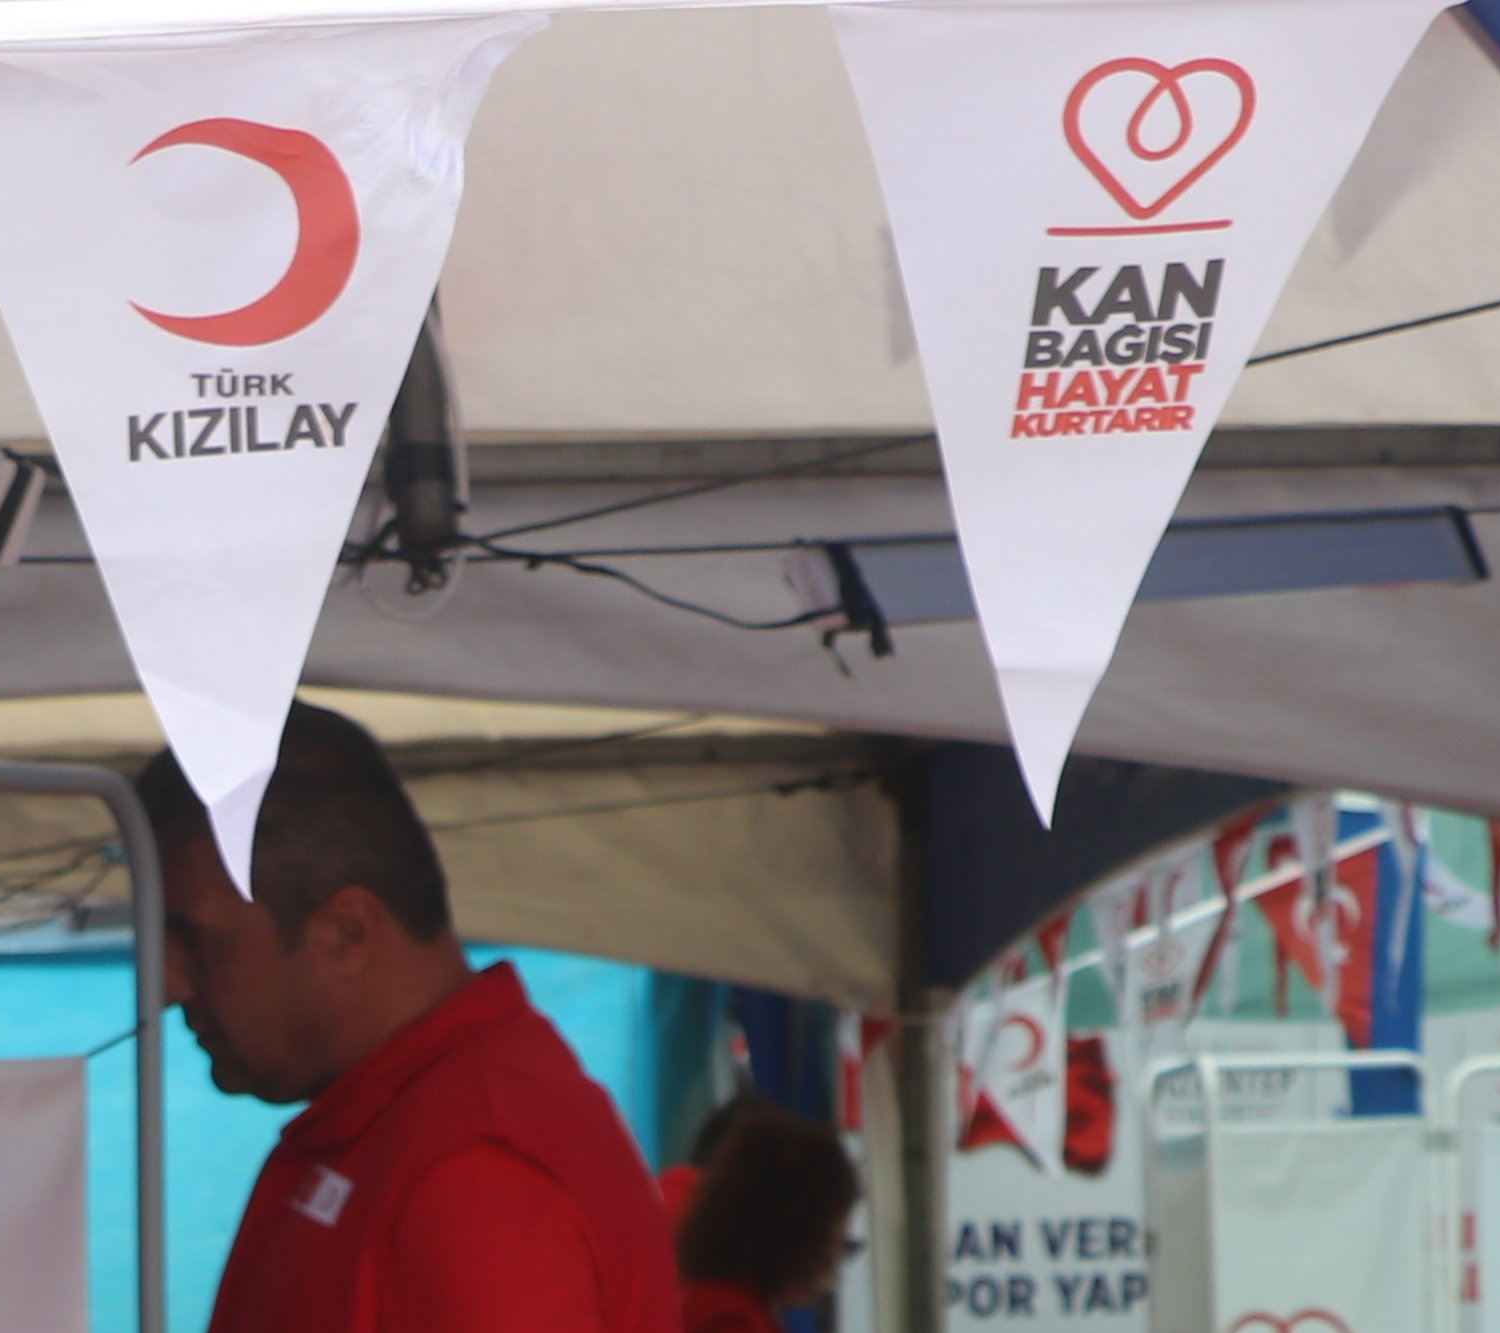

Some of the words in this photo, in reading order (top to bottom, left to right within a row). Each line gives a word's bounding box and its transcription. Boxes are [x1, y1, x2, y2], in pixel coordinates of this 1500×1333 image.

[1030, 258, 1226, 327] KAN
[190, 368, 295, 399] TÜRK
[1016, 363, 1206, 412] HAYAT
[127, 402, 359, 462] KIZILAY
[1010, 405, 1195, 439] KURTARIR
[953, 1220, 1023, 1261] AN
[945, 1273, 1038, 1319] POR
